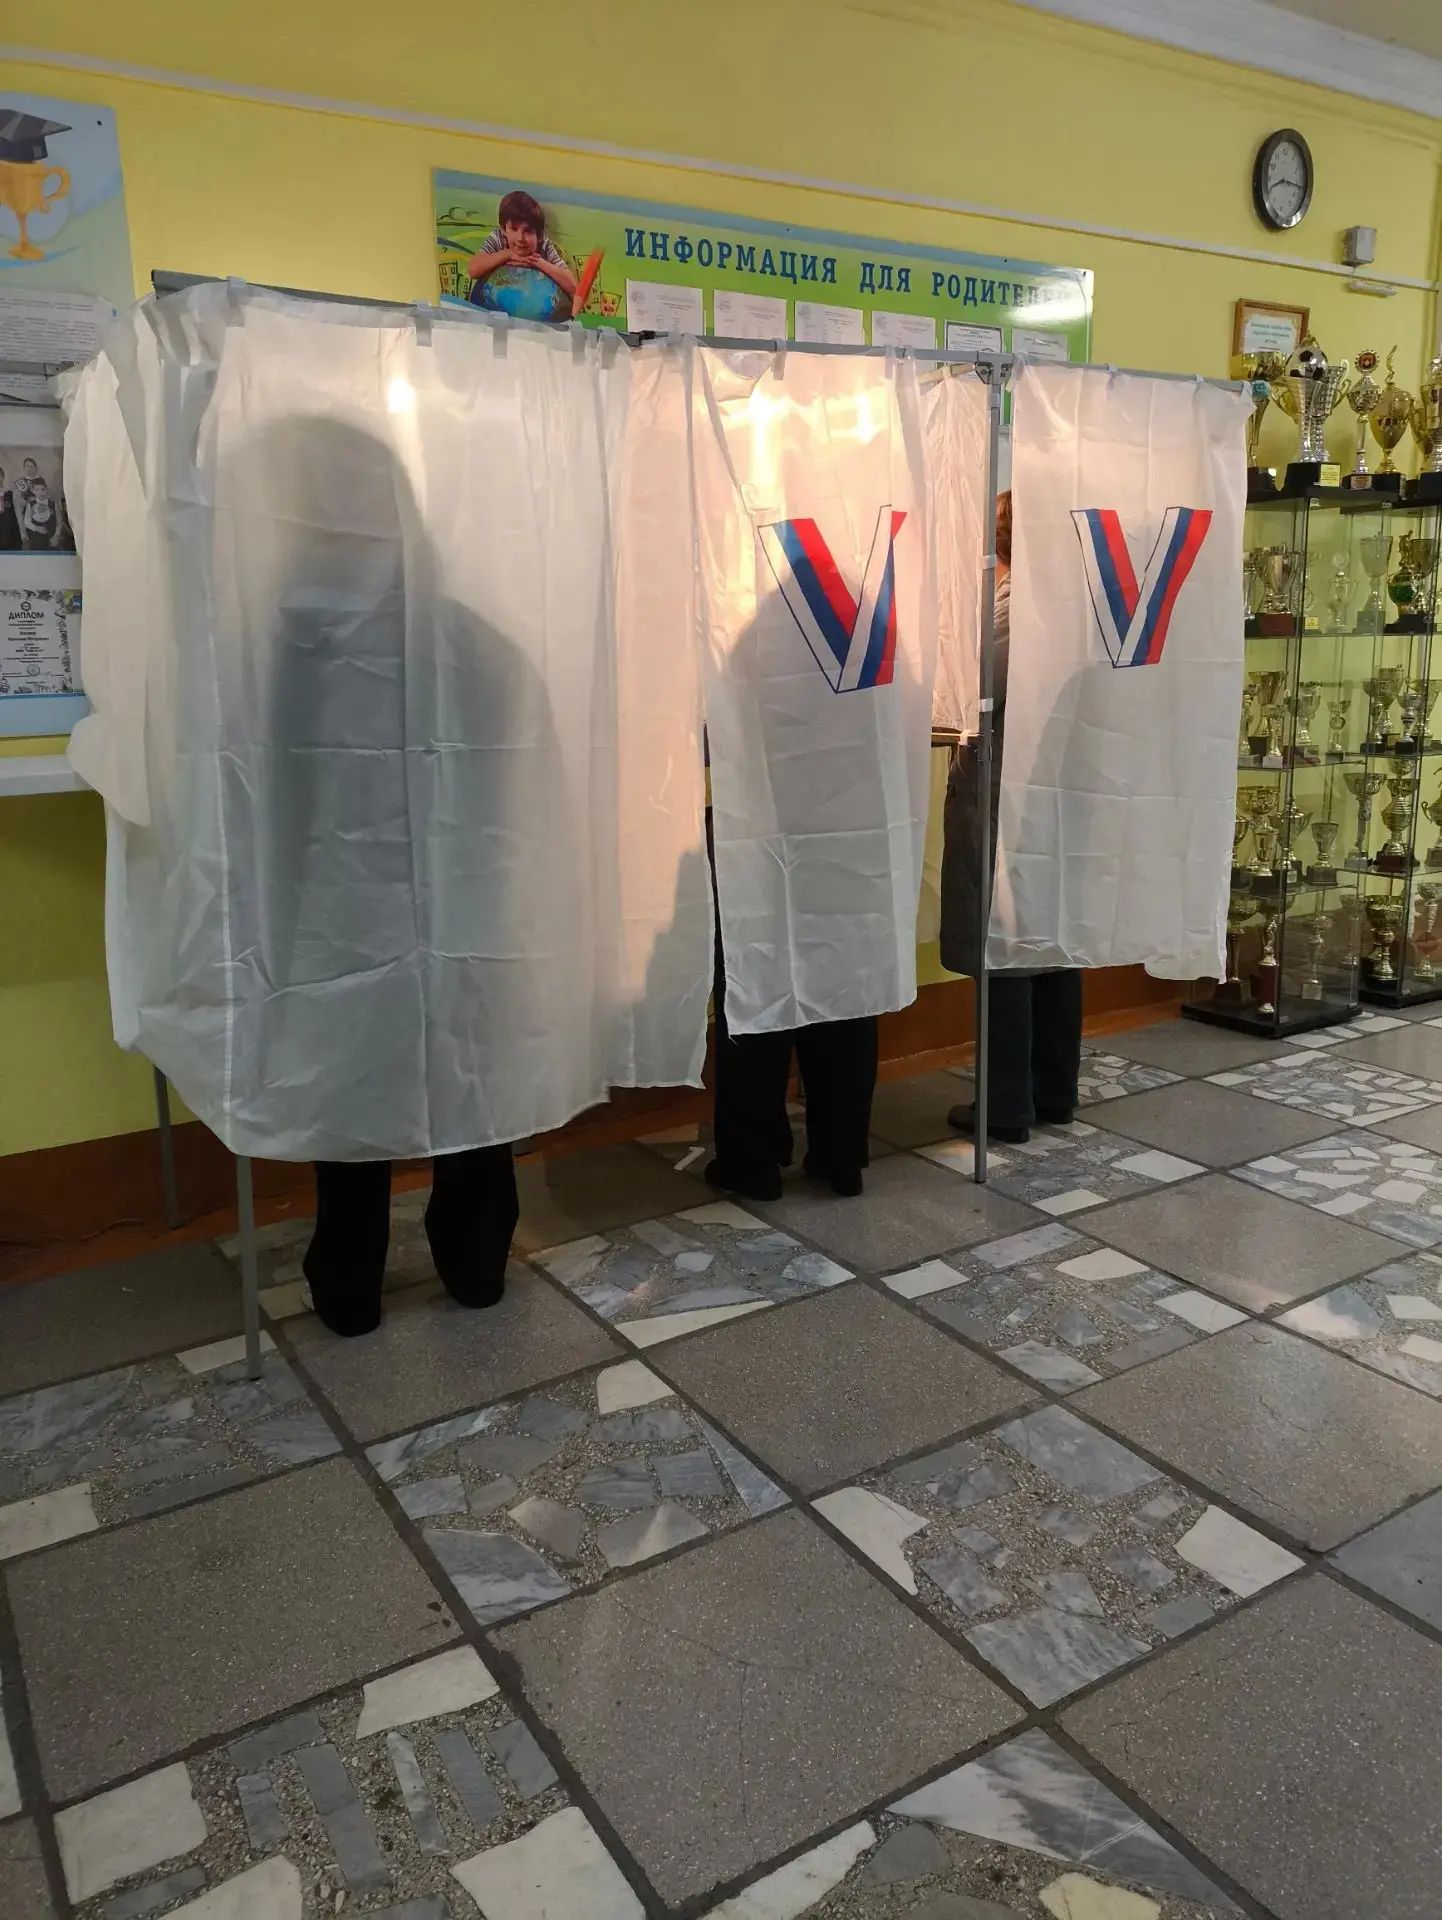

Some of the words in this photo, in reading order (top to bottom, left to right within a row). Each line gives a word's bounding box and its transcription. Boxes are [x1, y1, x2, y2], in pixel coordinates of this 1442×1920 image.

[625, 228, 837, 285] ИНФОРМАЦИЯ
[859, 262, 912, 295] ДЛЯ
[932, 271, 1072, 308] РОДИТЕЛ
[8, 611, 44, 619] ДИПЛОМ
